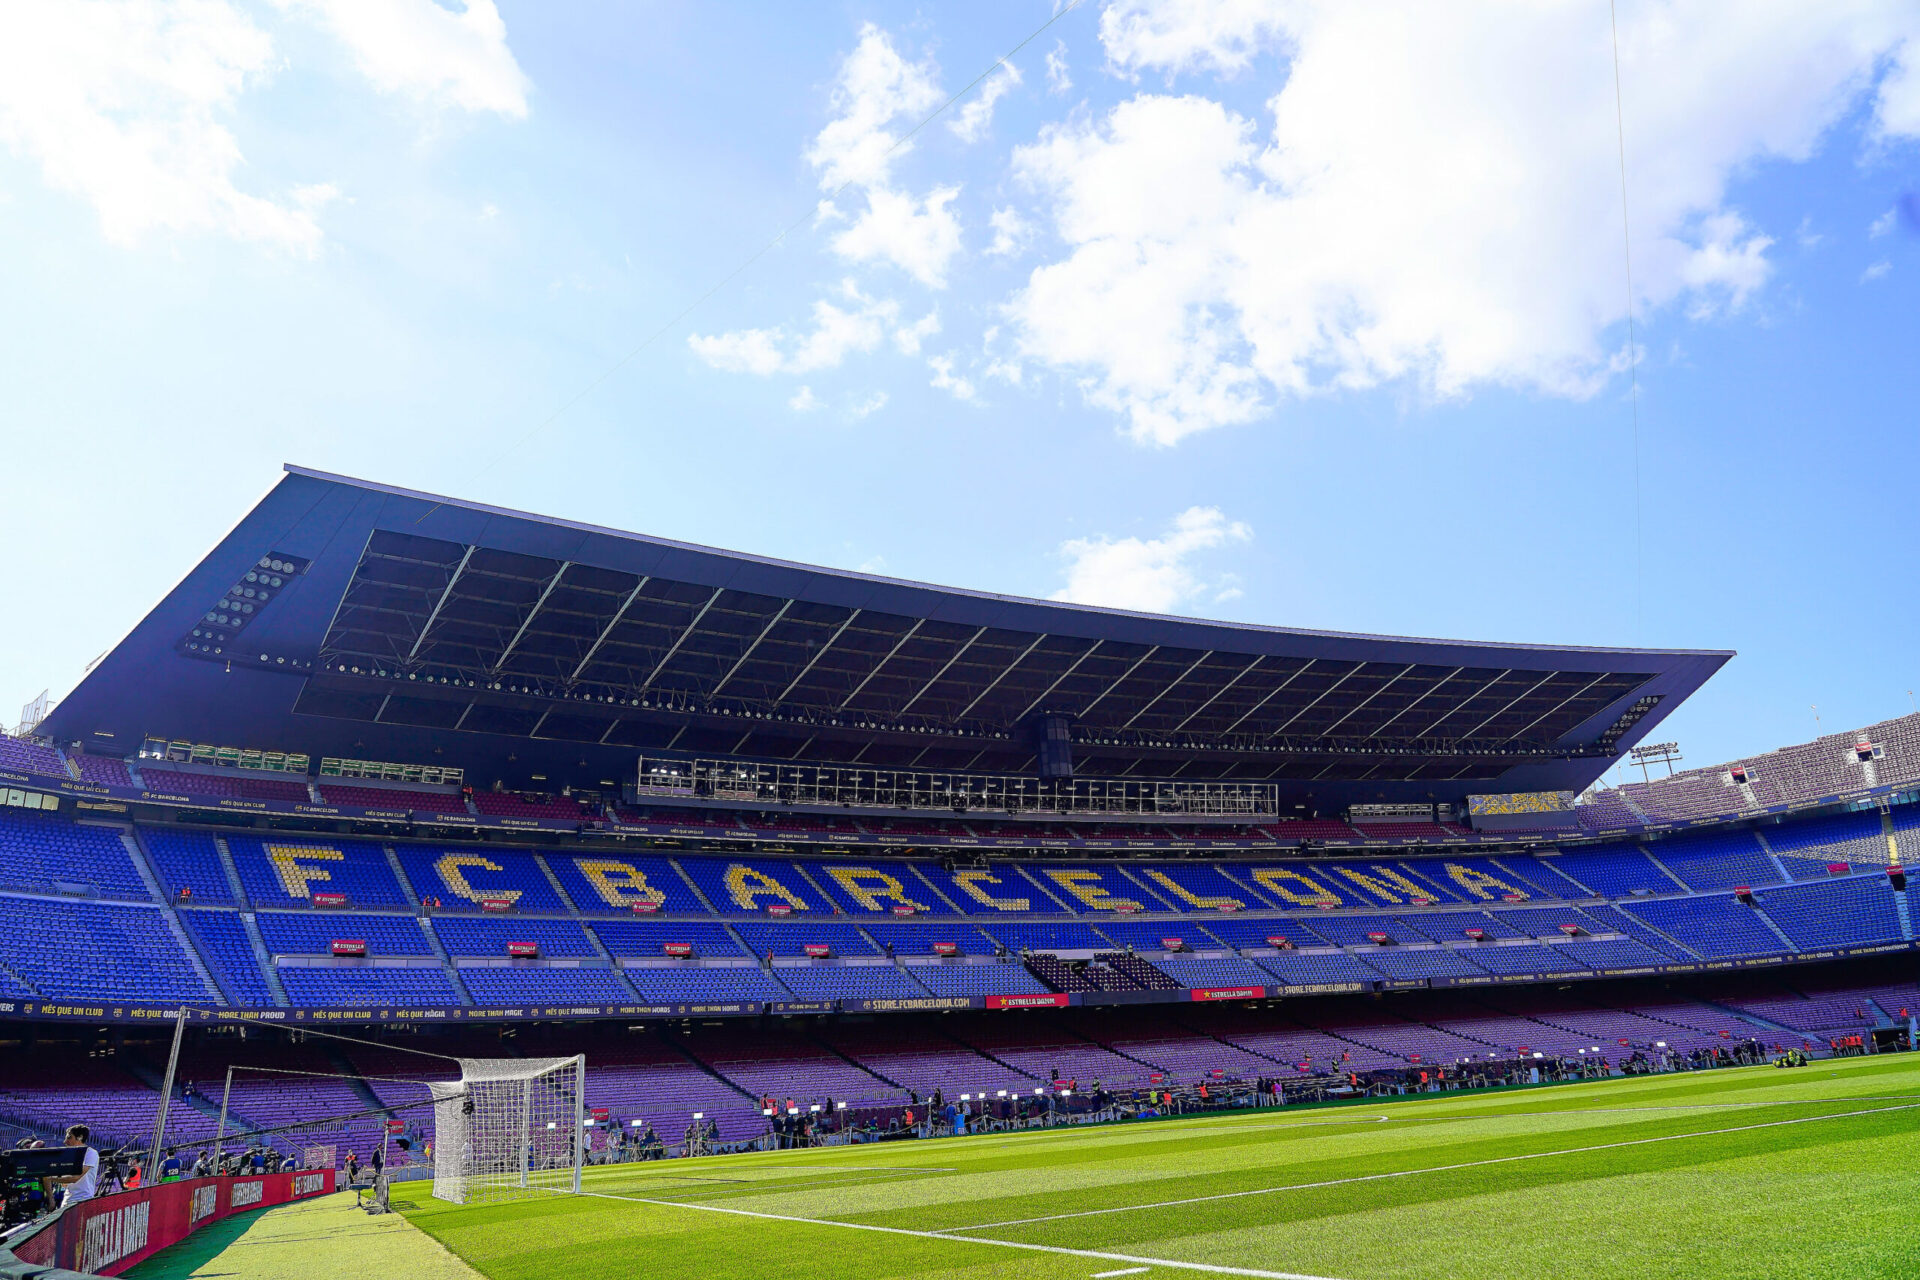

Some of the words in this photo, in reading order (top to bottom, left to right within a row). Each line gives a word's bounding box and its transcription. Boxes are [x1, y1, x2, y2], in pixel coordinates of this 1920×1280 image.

[873, 998, 970, 1009] STORE.FCBARCELONA.COM
[42, 1004, 56, 1014] MÉS
[57, 1006, 72, 1016] QUE
[85, 1007, 103, 1016] CLUB
[131, 1008, 145, 1017] MÉS
[147, 1010, 161, 1018] QUE
[163, 1010, 191, 1019] ORGL
[313, 1010, 326, 1018] MÉS
[328, 1012, 342, 1020] QUE
[397, 1010, 409, 1018] MÉS
[410, 1011, 423, 1019] QUE
[425, 1009, 445, 1018] MÀGIA
